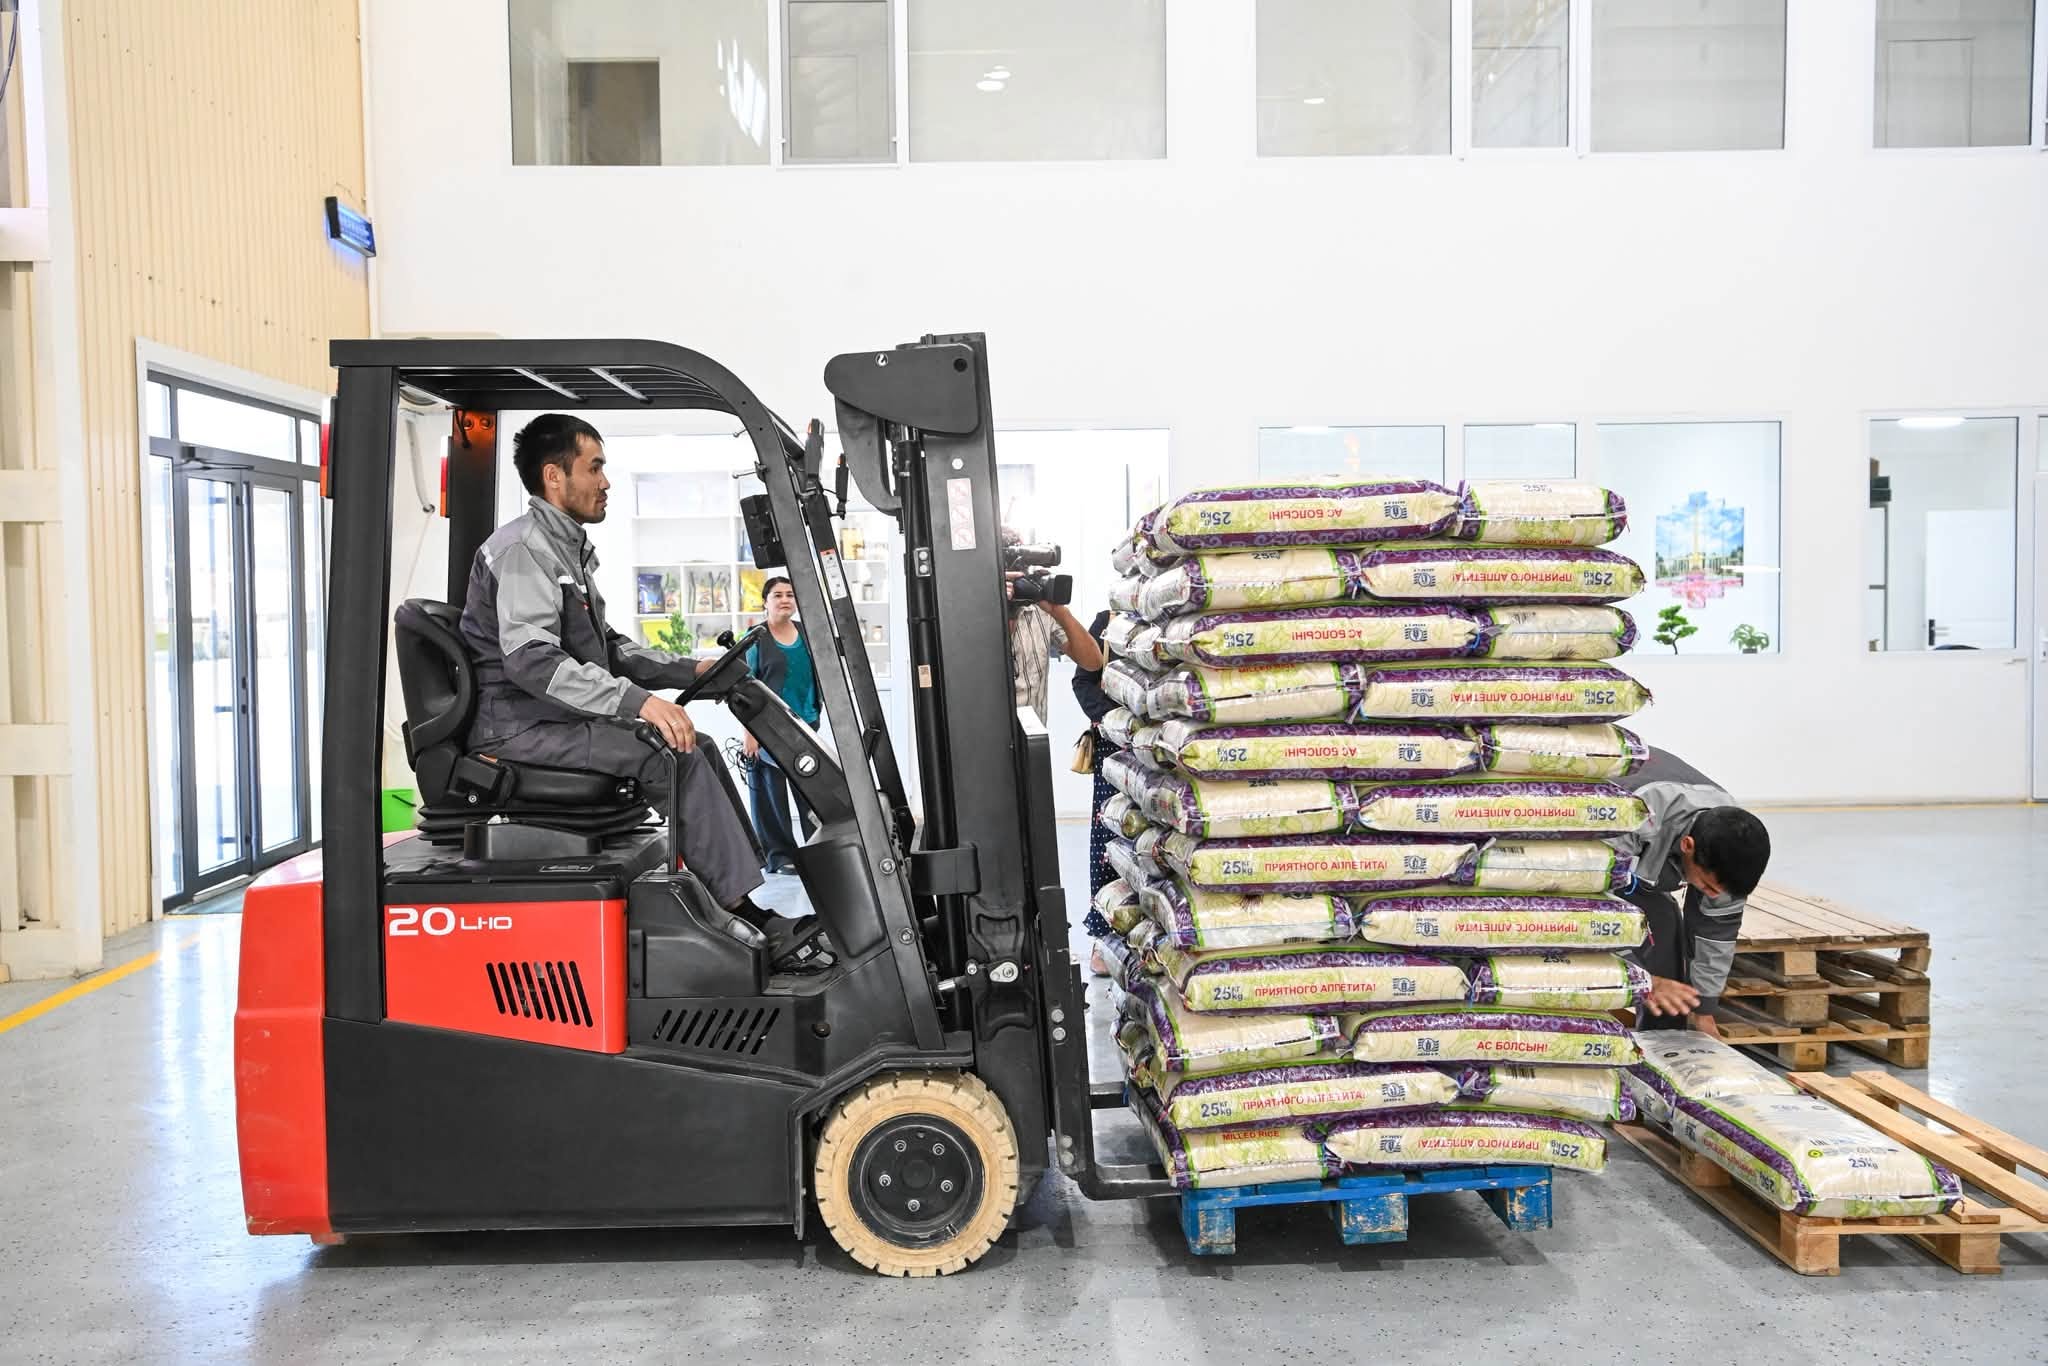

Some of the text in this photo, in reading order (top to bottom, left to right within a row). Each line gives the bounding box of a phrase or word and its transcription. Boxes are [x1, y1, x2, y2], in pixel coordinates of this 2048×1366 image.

[1211, 511, 1231, 525] 25
[1268, 508, 1343, 520] АС БОЛСЫН!
[1594, 572, 1613, 586] 25
[1235, 632, 1255, 647] 25
[1291, 628, 1362, 641] АС БОЛСЫН!
[1450, 691, 1574, 703] ПРИЯТНОГО АППЕТИТА!
[1595, 690, 1615, 705] 25
[1228, 748, 1248, 762] 25
[1284, 746, 1358, 758] АС БОЛСЫН!
[1455, 807, 1576, 818] ПРИЯТНОГО АППЕТИТА!
[1598, 807, 1617, 821] 25
[1222, 860, 1241, 874] 25
[1264, 859, 1388, 872] ПРИЯТНОГО АППЕТИТА!
[388, 907, 456, 936] 20
[1455, 922, 1512, 933] АППЕТИТА!
[1601, 922, 1621, 936] 25
[1214, 986, 1232, 1001] 25
[1255, 982, 1376, 998] ПРИЯТНОГО АППЕТИТА!
[1477, 1040, 1549, 1053] АС БОЛСЫН!
[1584, 1043, 1602, 1057] 25
[1201, 1103, 1220, 1118] 25
[1222, 1130, 1280, 1141] MILLED RICE
[1560, 1143, 1580, 1159] 25
